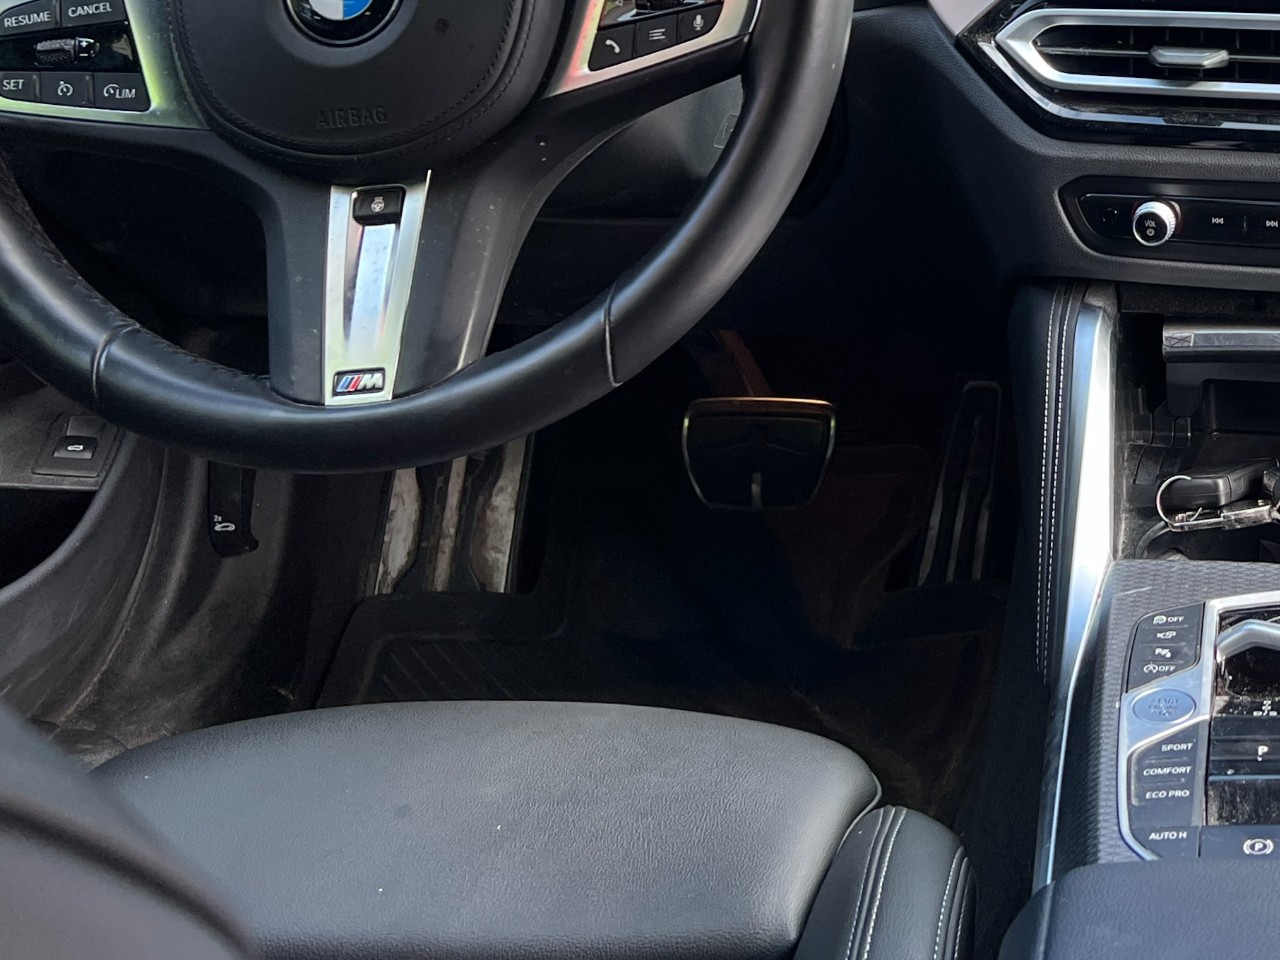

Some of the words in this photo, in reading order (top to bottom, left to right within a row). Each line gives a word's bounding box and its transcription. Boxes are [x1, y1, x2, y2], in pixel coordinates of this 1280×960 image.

[68, 2, 113, 17] CANCEL
[4, 11, 51, 28] RESUME
[3, 79, 24, 90] SET
[115, 86, 136, 99] LIM
[316, 107, 387, 129] AIRBAG
[1144, 219, 1156, 228] VOL
[1161, 742, 1193, 752] SPORT
[1143, 766, 1192, 776] COMFORT
[1145, 791, 1166, 800] ECO
[1168, 789, 1190, 799] PRO
[1148, 831, 1177, 841] AUTO
[1179, 831, 1188, 839] H
